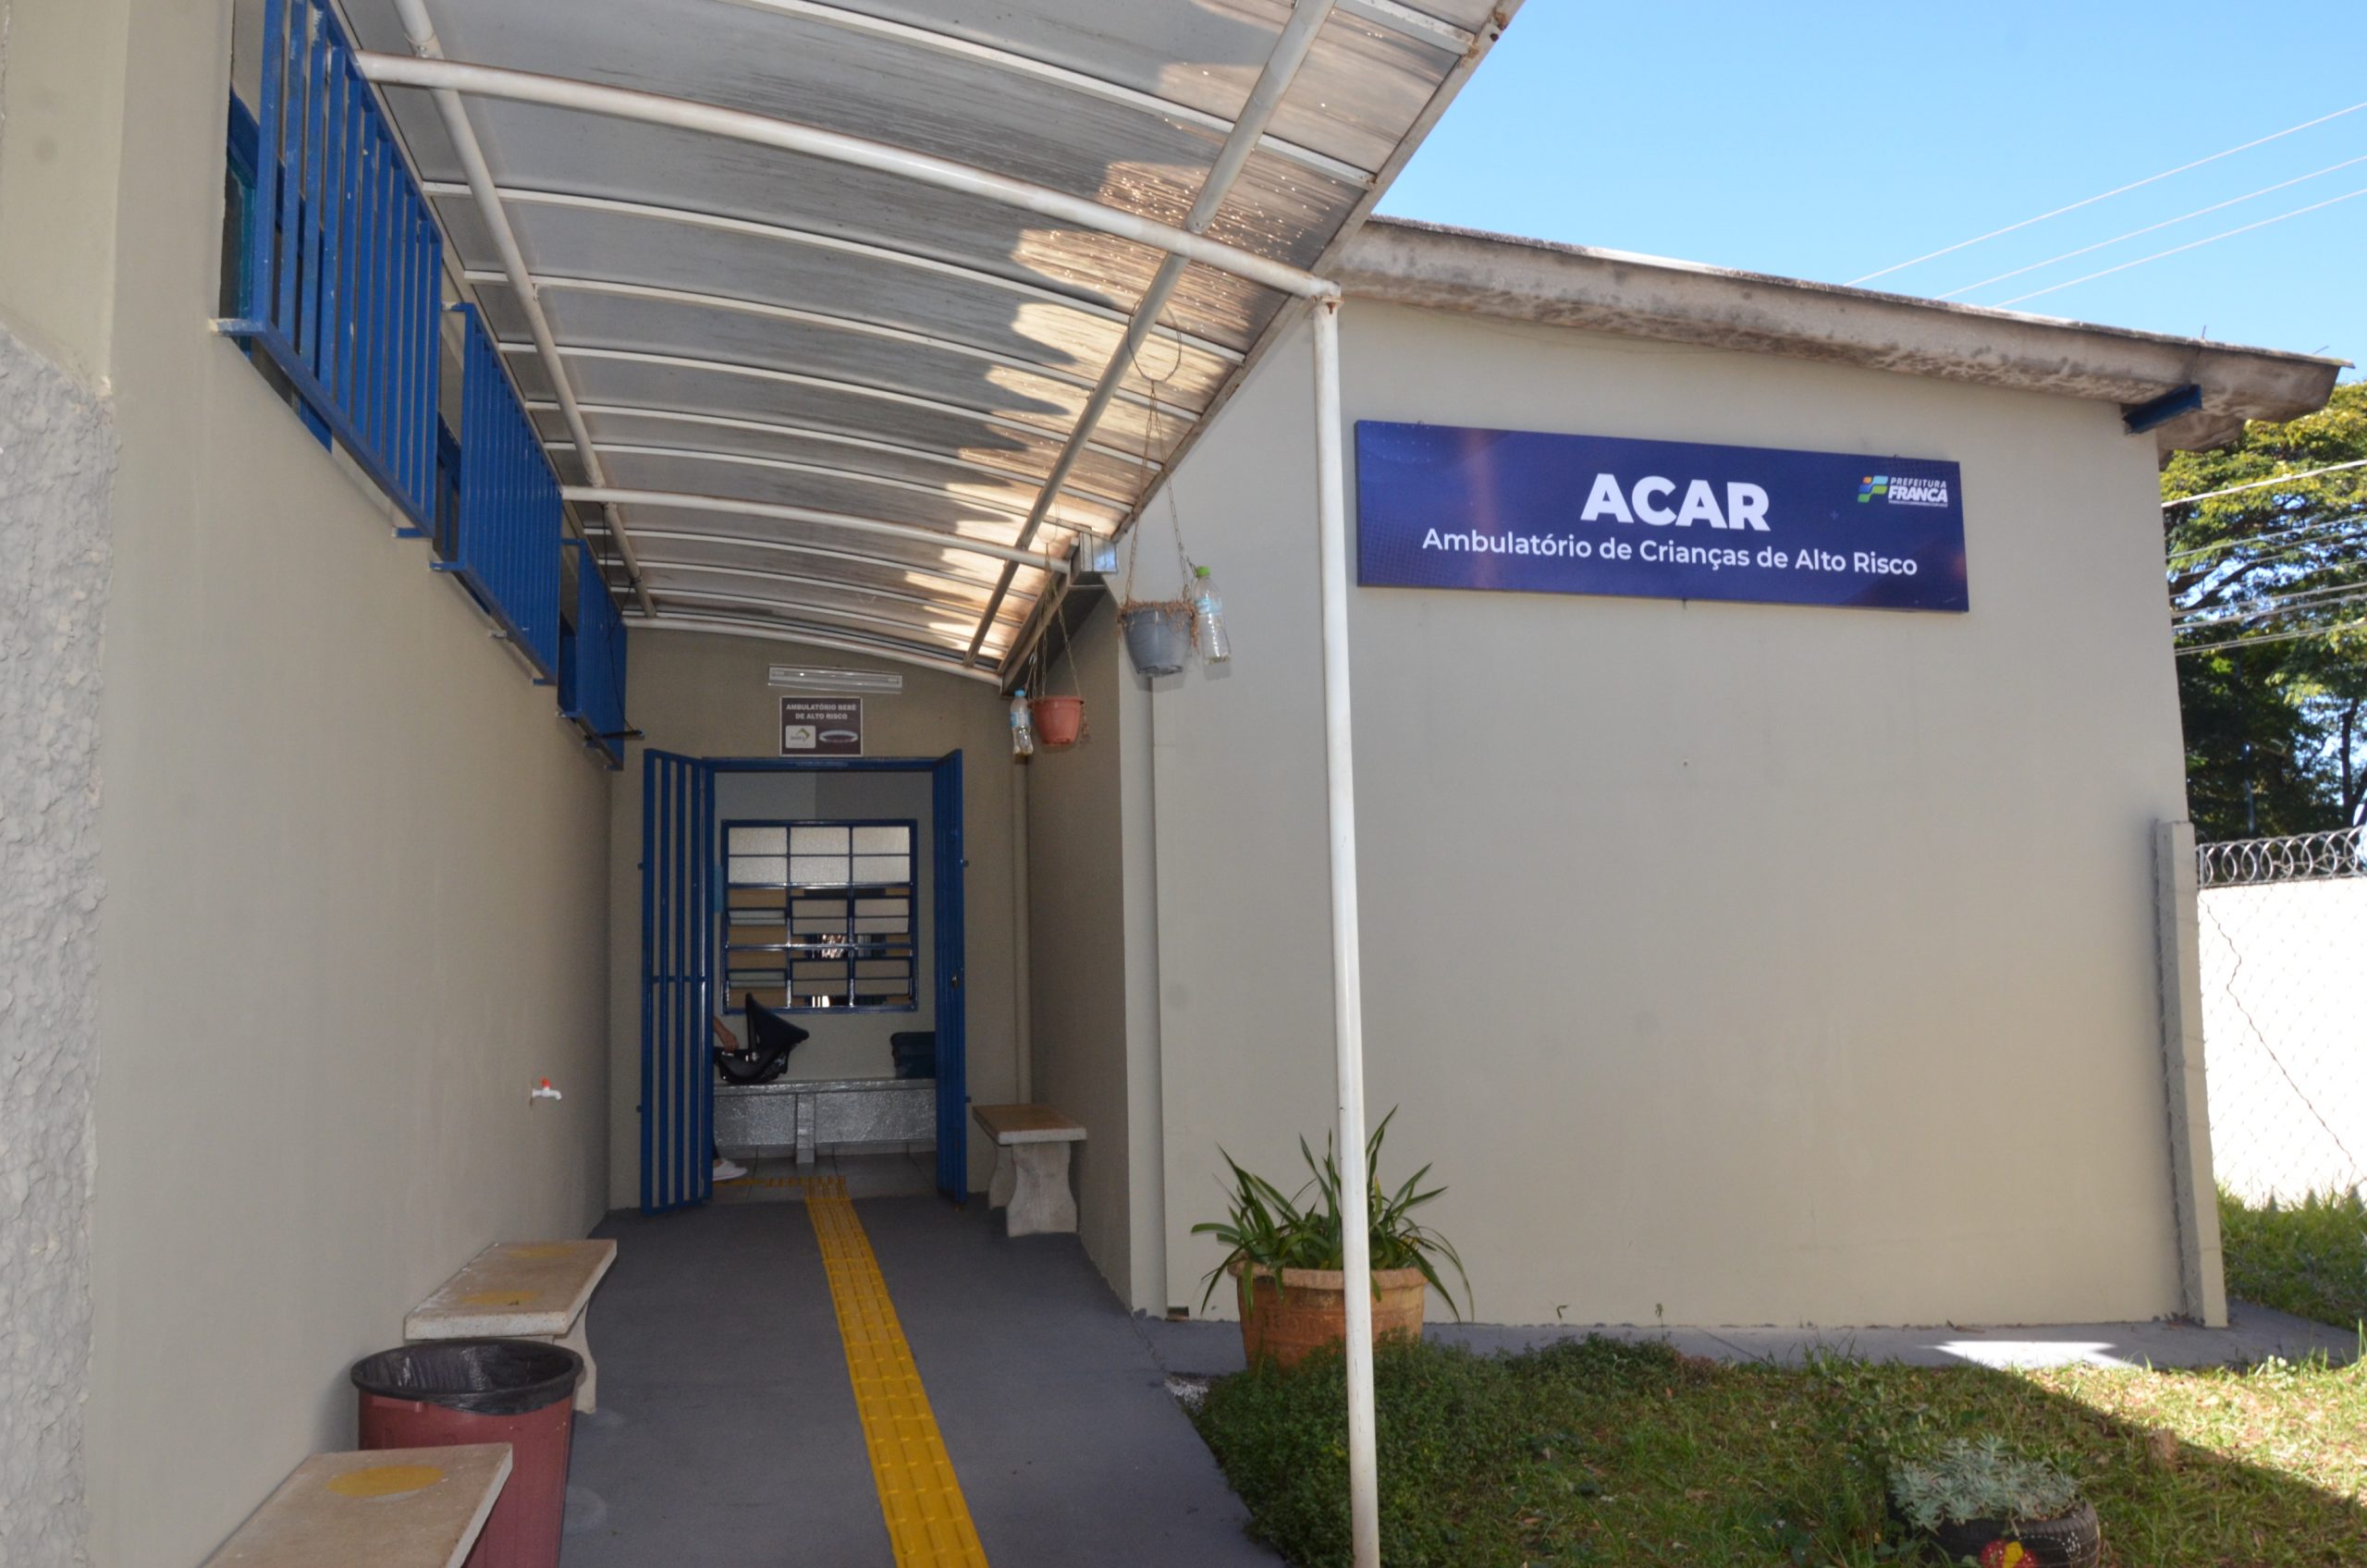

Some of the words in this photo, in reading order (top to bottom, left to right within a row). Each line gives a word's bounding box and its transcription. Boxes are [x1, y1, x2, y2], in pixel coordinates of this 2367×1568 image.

[1888, 485, 1948, 503] FRANCA
[1890, 477, 1946, 488] PREFEITURA
[1579, 472, 1771, 532] ACAR
[1422, 528, 1592, 557] Ambulatório
[1599, 536, 1633, 560] de
[1639, 540, 1750, 570] Crianças
[1756, 545, 1788, 569] de
[1795, 548, 1846, 571] Alto
[1853, 551, 1918, 576] Risco
